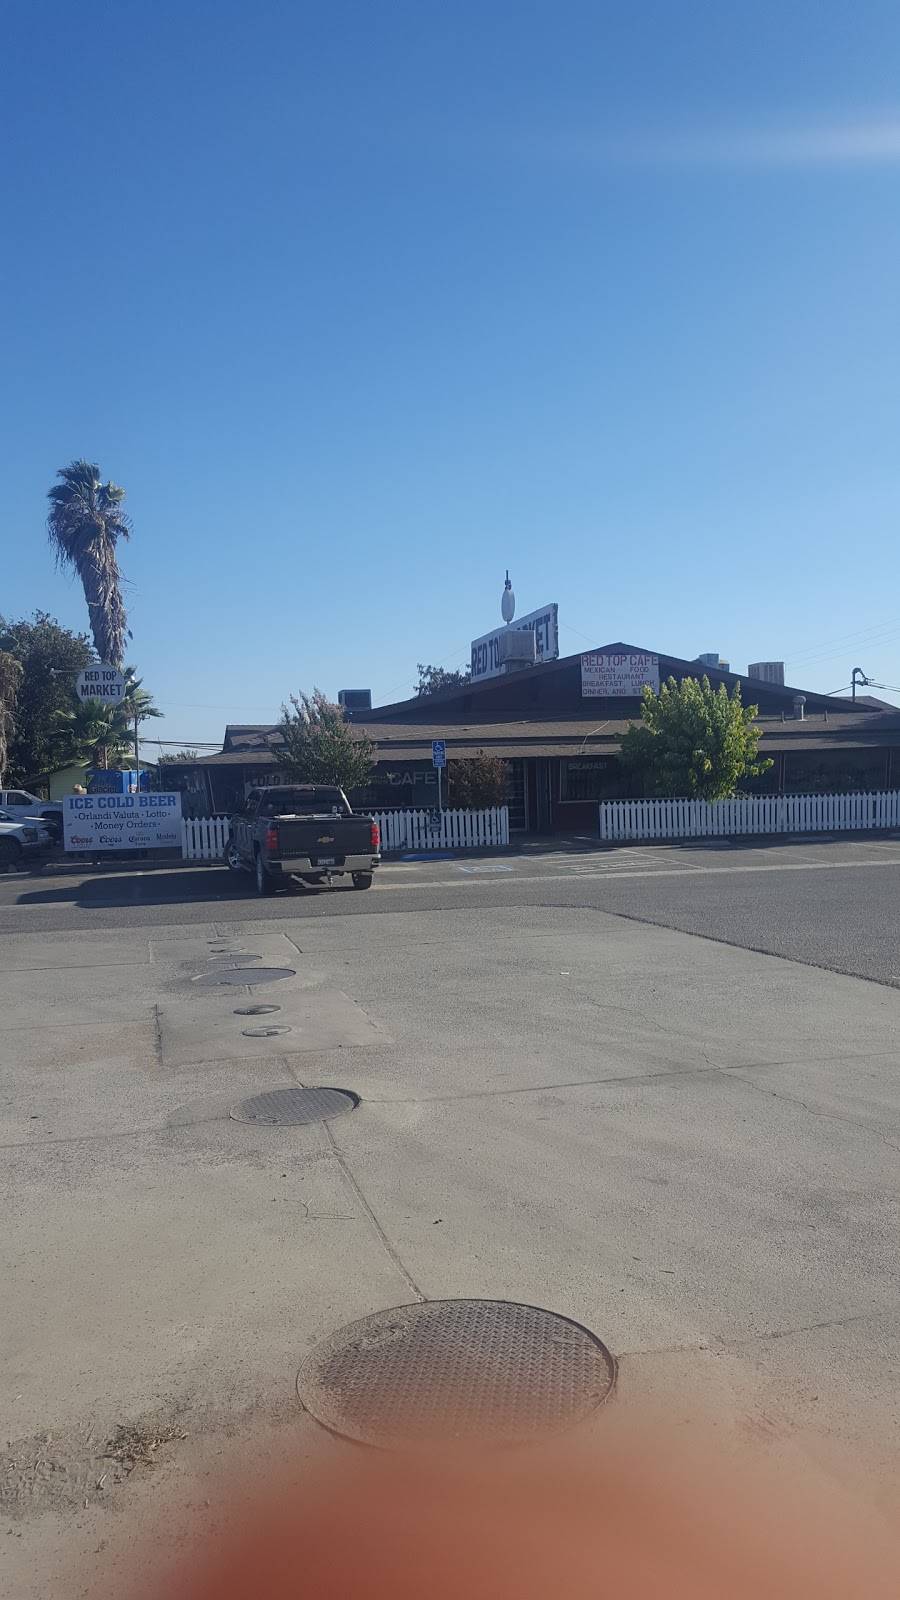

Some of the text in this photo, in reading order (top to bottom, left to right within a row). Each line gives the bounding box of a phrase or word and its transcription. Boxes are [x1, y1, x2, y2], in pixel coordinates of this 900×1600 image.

[471, 641, 487, 677] RED
[582, 655, 659, 666] RED TOP CAFE
[84, 670, 117, 682] RED TOP
[80, 684, 122, 696] MARKET
[389, 771, 437, 785] CAFE
[69, 795, 176, 809] ICE COLD BEER
[78, 810, 167, 821] Orlandi Valuta Lotto
[94, 820, 157, 831] Money Orders
